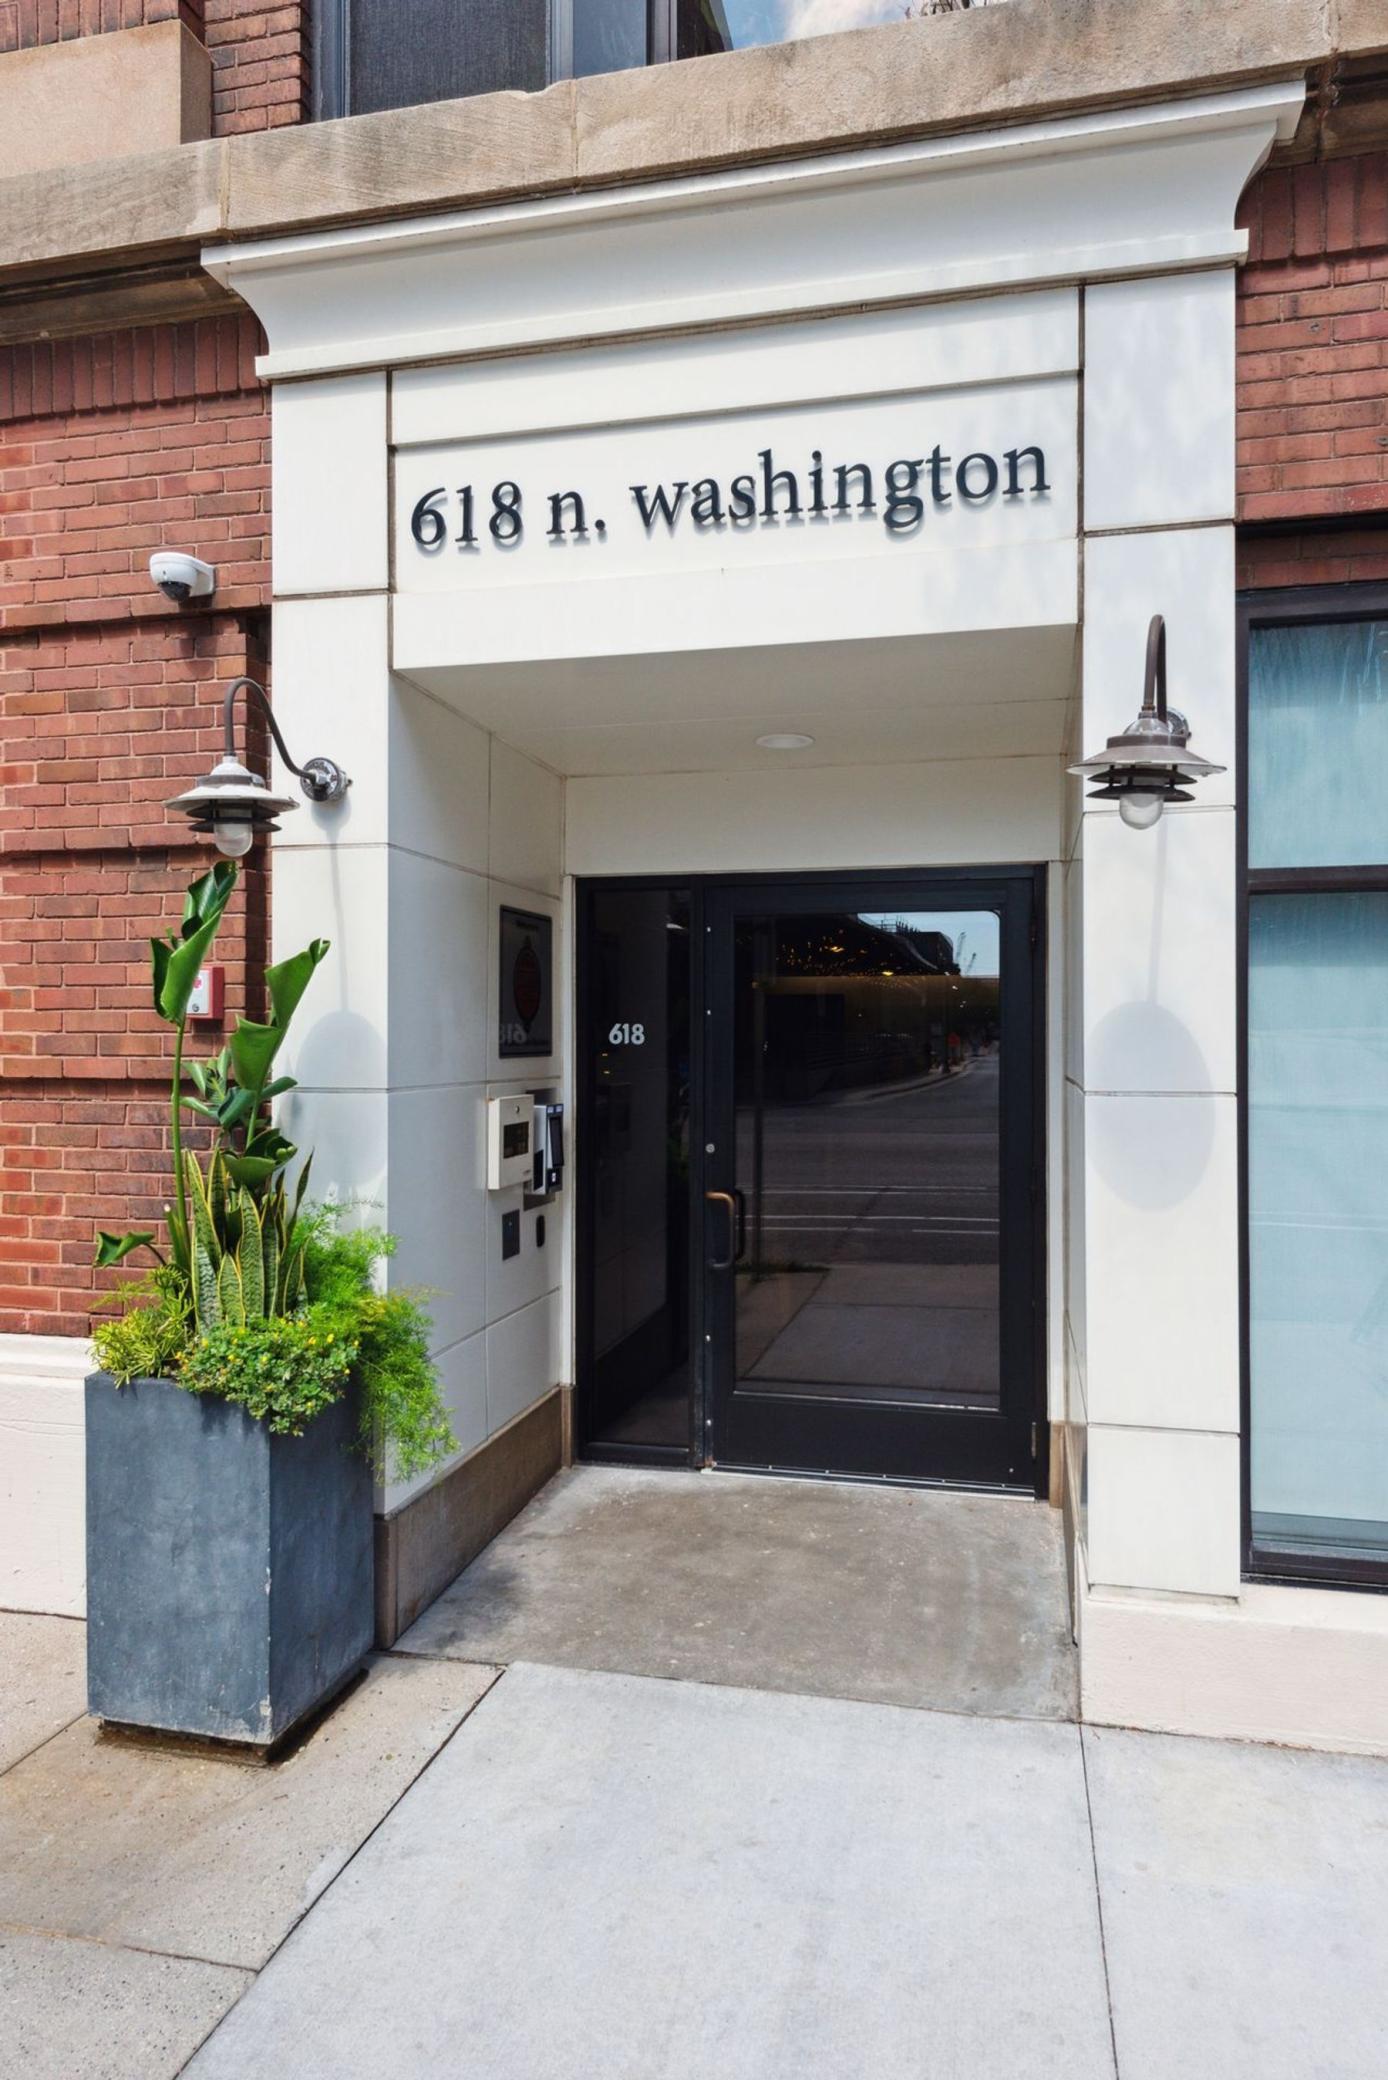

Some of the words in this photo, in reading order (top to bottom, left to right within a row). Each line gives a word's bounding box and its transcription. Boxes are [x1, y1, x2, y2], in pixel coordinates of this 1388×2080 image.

[411, 481, 523, 545] 618
[546, 491, 605, 535] n.
[629, 444, 1051, 529] washington
[608, 1023, 645, 1045] 618
